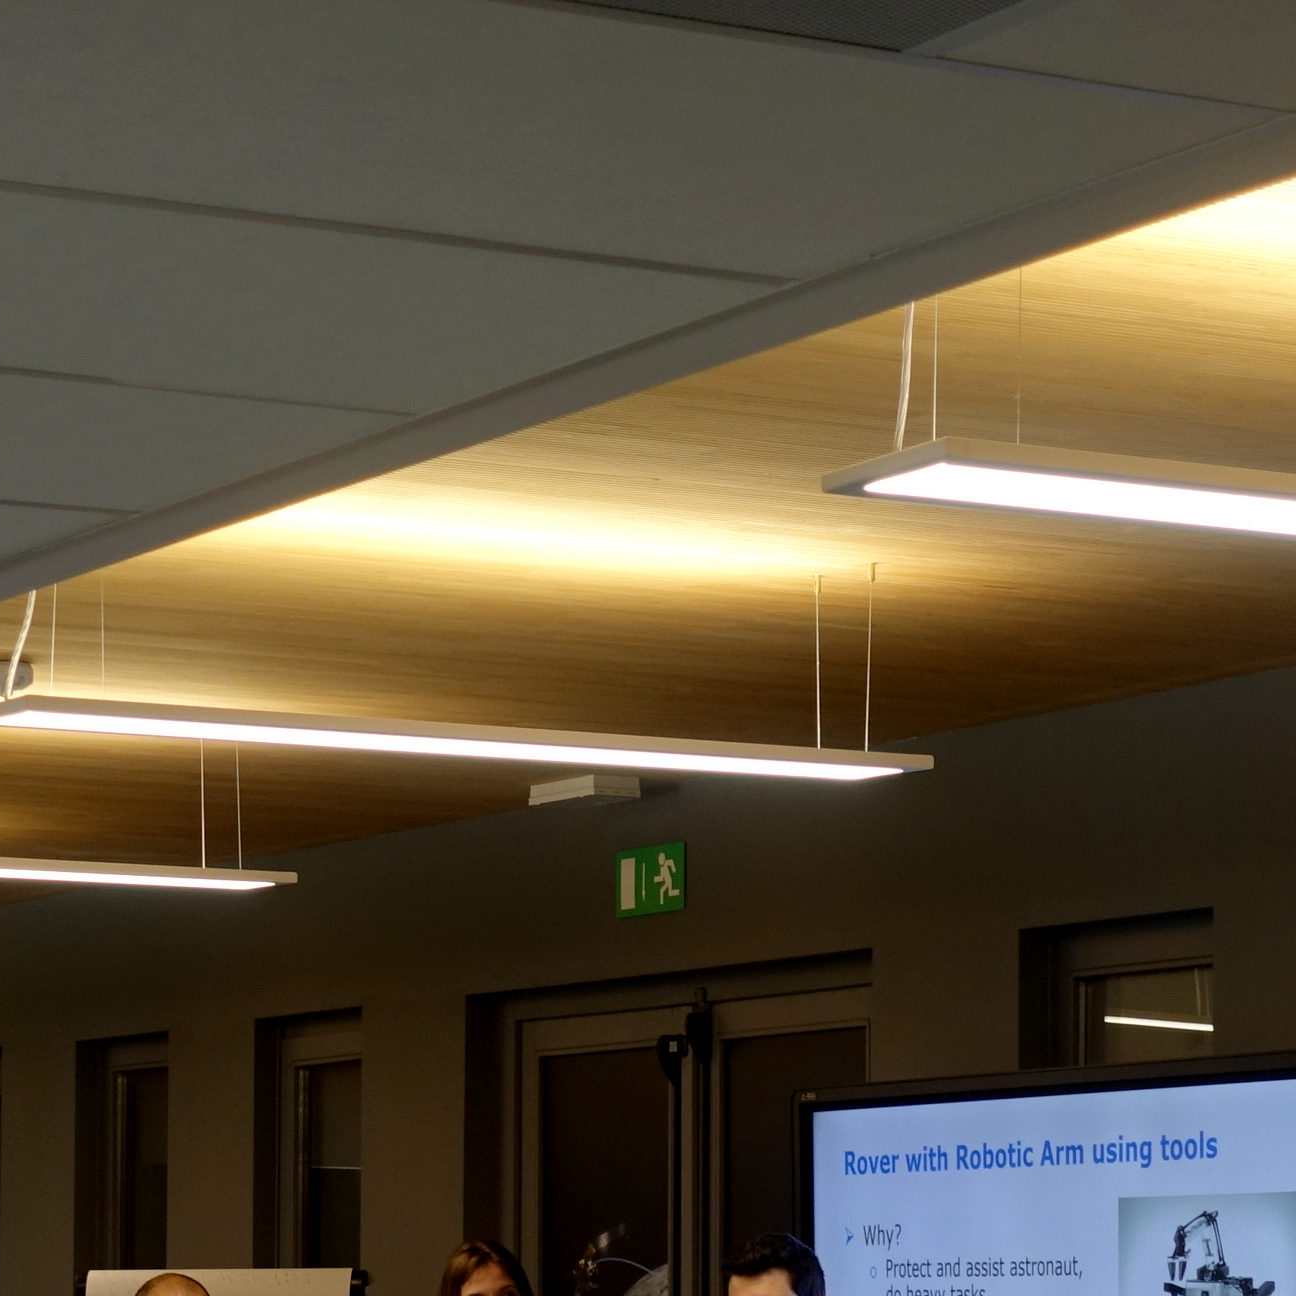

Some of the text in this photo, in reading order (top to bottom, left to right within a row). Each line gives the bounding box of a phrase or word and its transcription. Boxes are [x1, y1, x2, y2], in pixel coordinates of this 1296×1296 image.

[844, 1130, 1217, 1175] Rover with Robotic Arm using tools
[862, 1223, 901, 1250] Why?
[885, 1255, 1082, 1279] Protect and assist astronaut,
